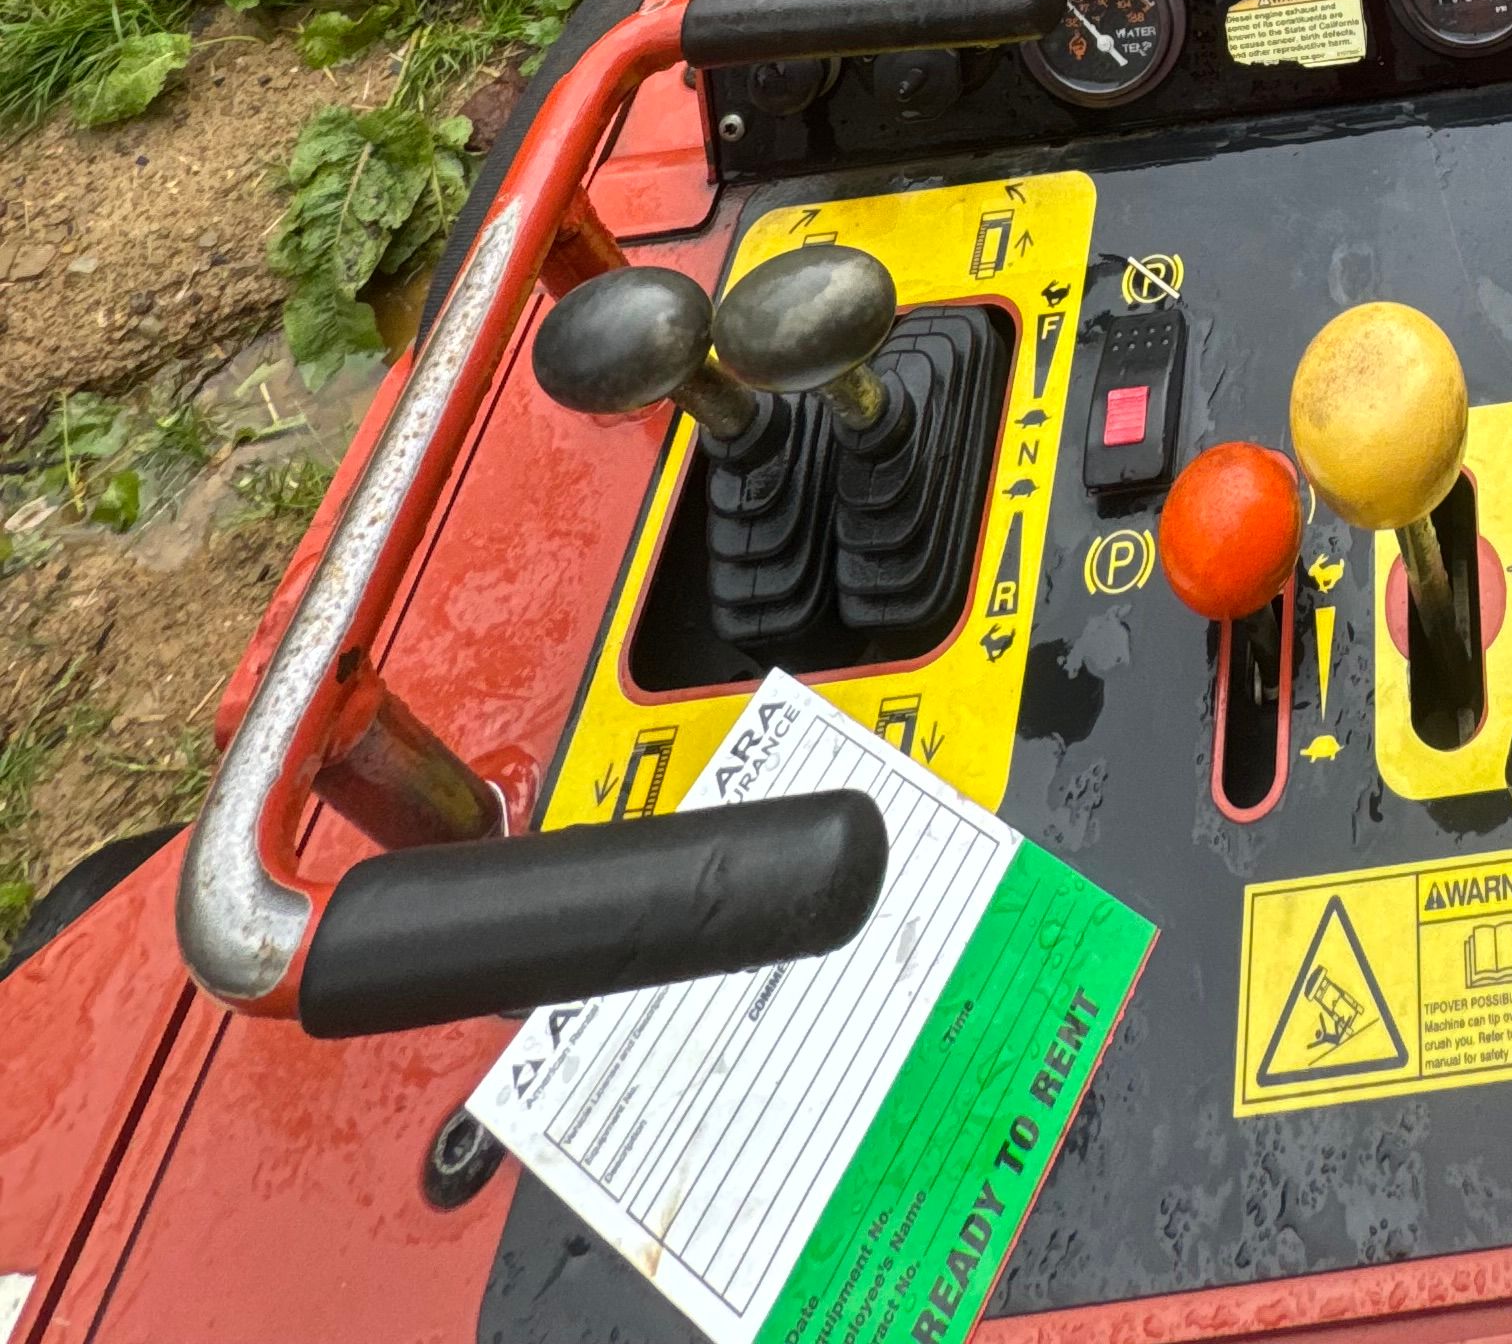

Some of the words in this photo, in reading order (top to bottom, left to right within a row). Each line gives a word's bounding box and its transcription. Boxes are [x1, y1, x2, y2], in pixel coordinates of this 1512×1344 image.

[1227, 24, 1250, 32] some
[1253, 21, 1261, 29] of
[1263, 20, 1273, 28] its
[1275, 14, 1327, 26] constituents
[1329, 11, 1343, 19] are
[1255, 11, 1283, 22] engine
[1285, 6, 1318, 16] exhaust
[1321, 2, 1336, 11] and
[1115, 26, 1156, 39] WATER
[1228, 33, 1256, 42] known
[1258, 30, 1266, 38] to
[1269, 28, 1282, 36] the
[1284, 25, 1306, 34] State
[1308, 23, 1316, 31] of
[1319, 19, 1360, 30] California
[1240, 41, 1265, 50] cause
[1301, 33, 1320, 42] birth
[1249, 48, 1270, 57] other
[1273, 41, 1326, 55] reproductive
[1041, 315, 1063, 340] F
[1018, 439, 1039, 465] N
[993, 581, 1018, 612] R
[715, 701, 787, 799] ARA
[748, 962, 786, 1022] COMME
[1424, 998, 1468, 1015] TIPOVER
[943, 999, 974, 1044] Time
[1425, 1015, 1465, 1033] Machine
[1468, 1014, 1486, 1027] can
[1488, 1009, 1500, 1027] tip
[1424, 1036, 1452, 1052] crush
[1478, 1029, 1504, 1044] Refer
[1425, 1053, 1461, 1071] manual
[1464, 1049, 1477, 1065] for
[1480, 1045, 1509, 1064] safety
[910, 1178, 1006, 1344] READY
[994, 1115, 1041, 1176] TO
[1029, 985, 1100, 1110] RENT
[867, 1207, 894, 1242] No.
[889, 1190, 927, 1253] Name
[894, 1260, 921, 1297] No.
